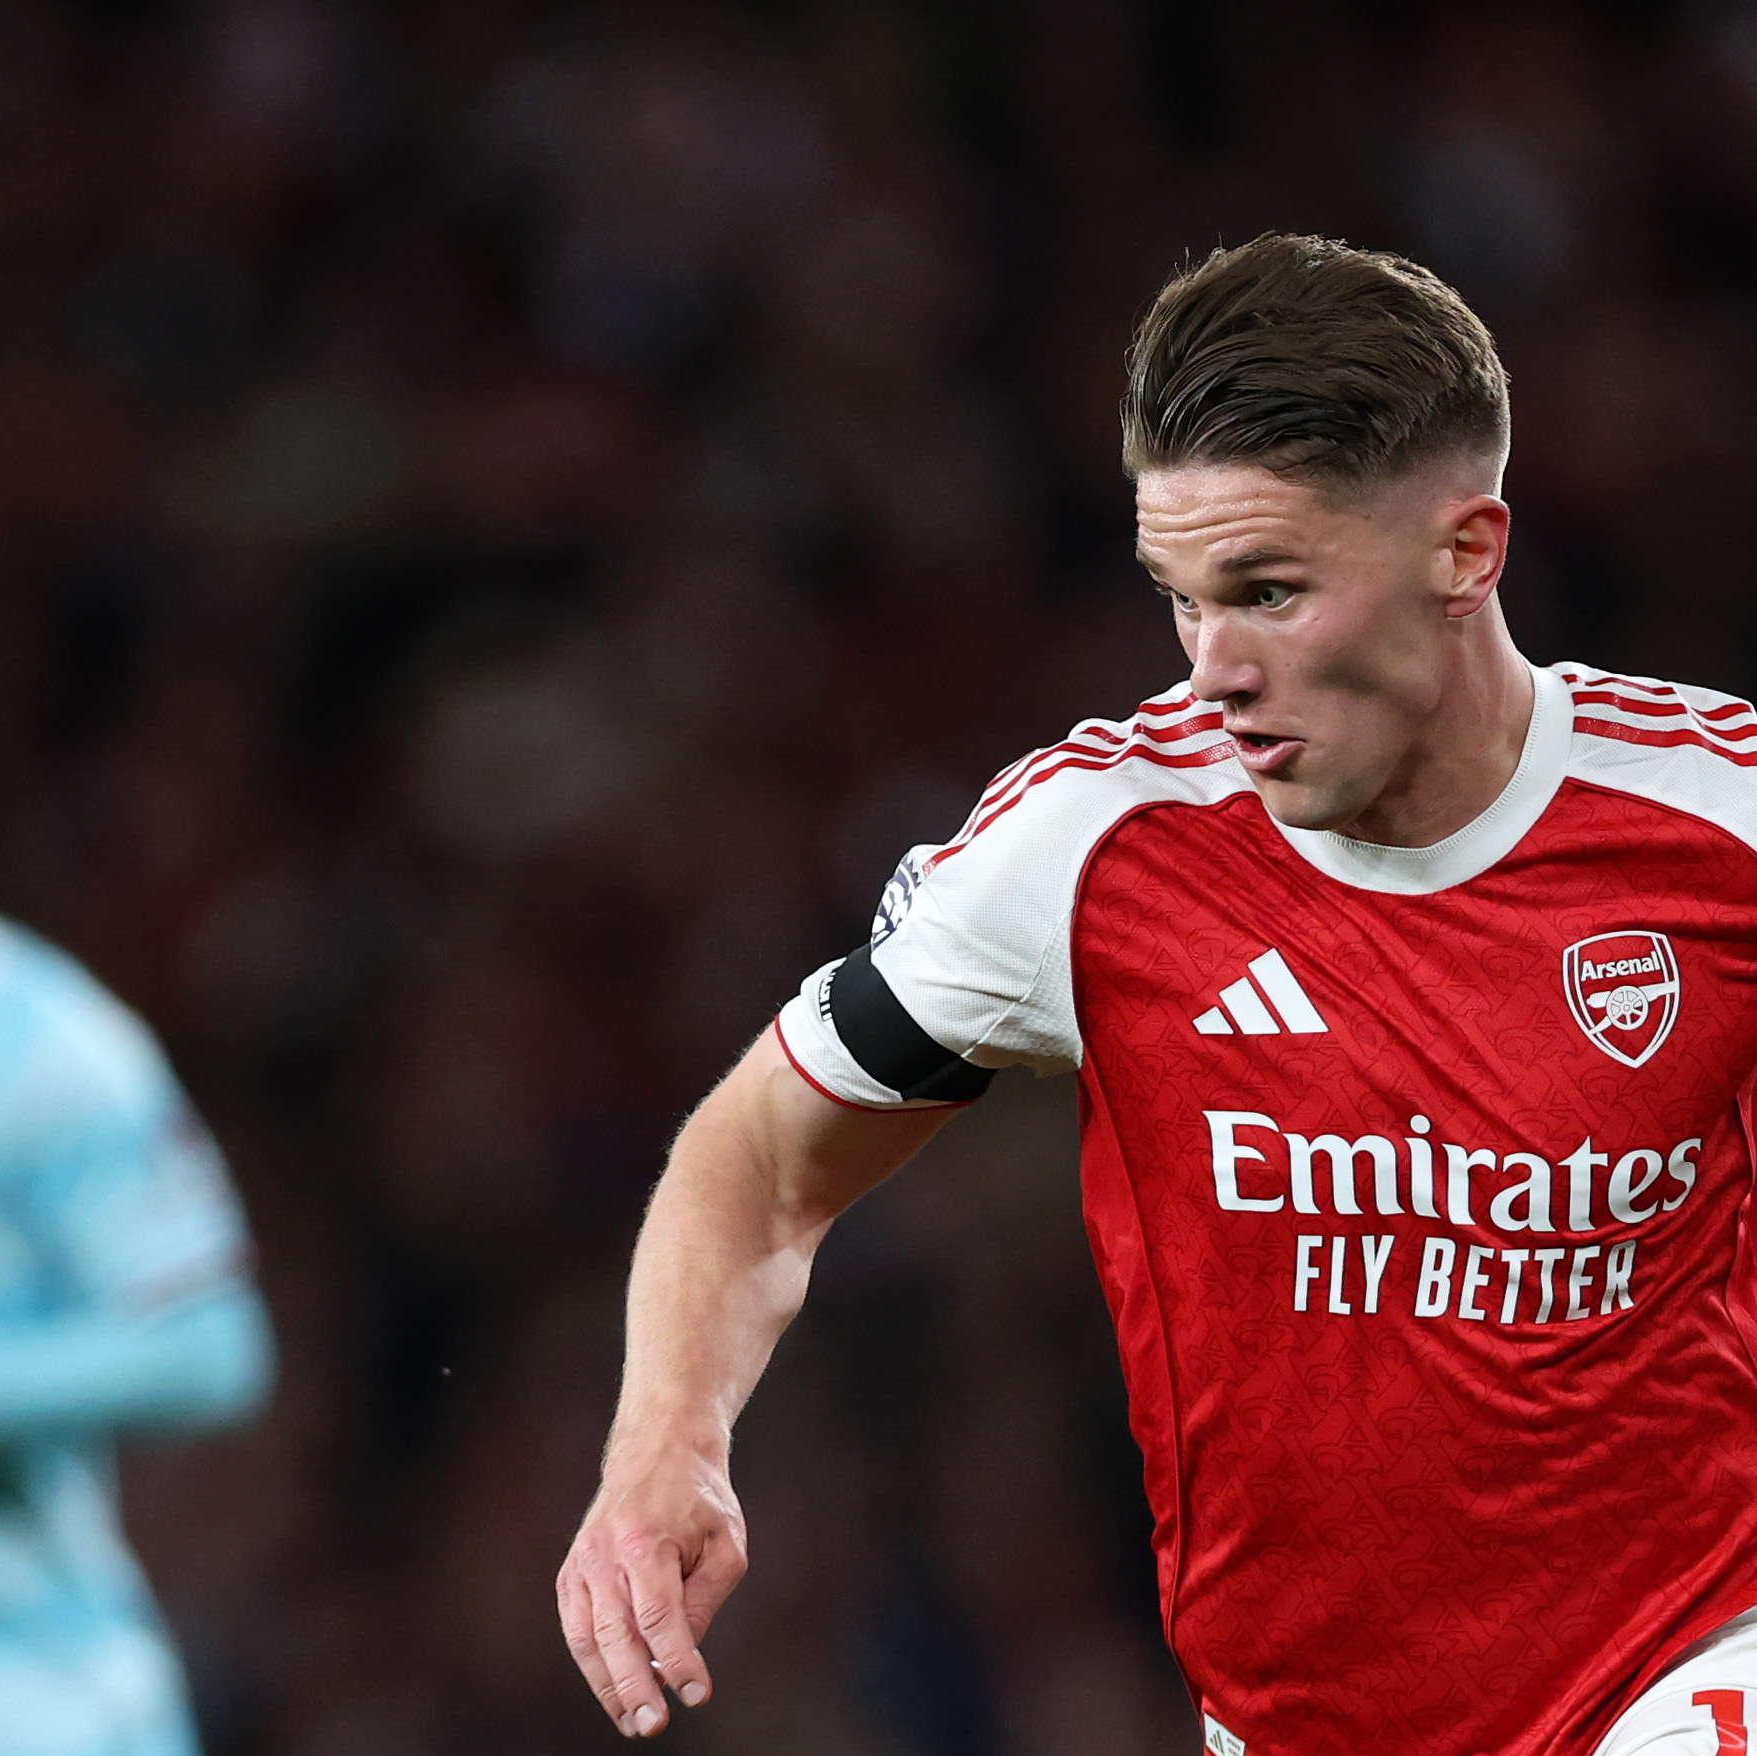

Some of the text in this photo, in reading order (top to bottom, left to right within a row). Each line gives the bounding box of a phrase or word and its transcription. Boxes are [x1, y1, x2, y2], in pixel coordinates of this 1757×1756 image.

[1580, 950, 1662, 982] Arsenal
[1202, 1110, 1702, 1233] Emirates
[1293, 1234, 1636, 1325] FLY BETTER
